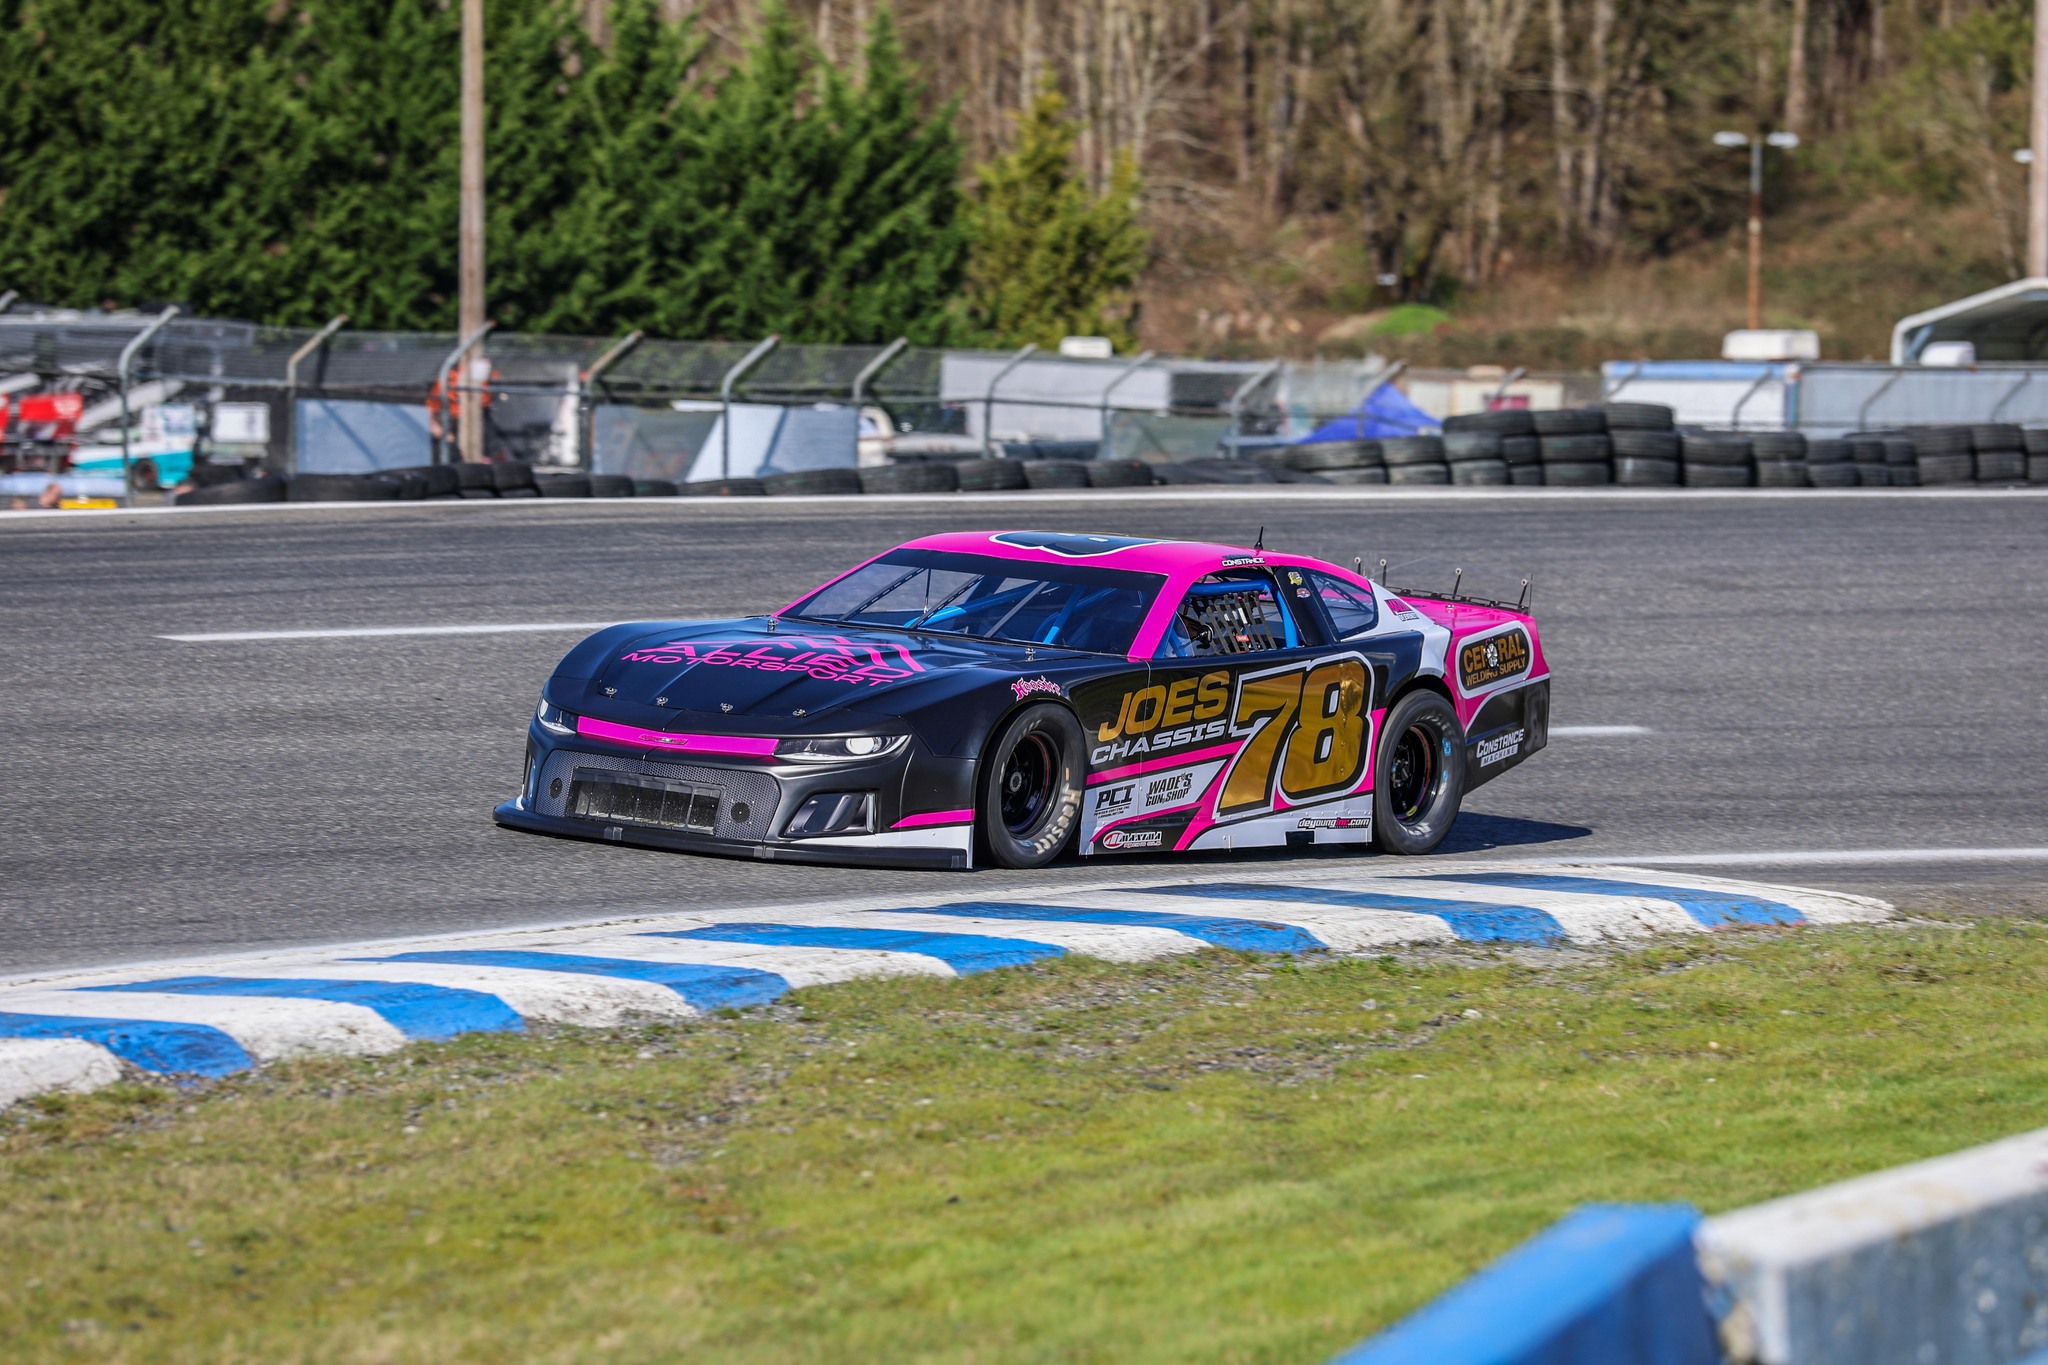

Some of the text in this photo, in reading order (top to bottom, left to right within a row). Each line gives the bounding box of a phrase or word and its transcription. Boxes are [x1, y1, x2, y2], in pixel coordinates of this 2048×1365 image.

[1222, 557, 1265, 567] CONSTANCE
[621, 652, 894, 687] MOTORSPORT
[637, 644, 914, 679] ALLIED
[1499, 656, 1526, 675] SUPPLY
[1011, 675, 1061, 702] Hoosier
[1097, 670, 1230, 742] JOES
[1090, 719, 1227, 765] CHASSIS
[1216, 655, 1371, 816] 78
[1482, 746, 1517, 765] MACHINE
[1096, 784, 1136, 809] PCI
[1145, 787, 1190, 807] GUN SHOP
[1148, 772, 1193, 796] WADE'S
